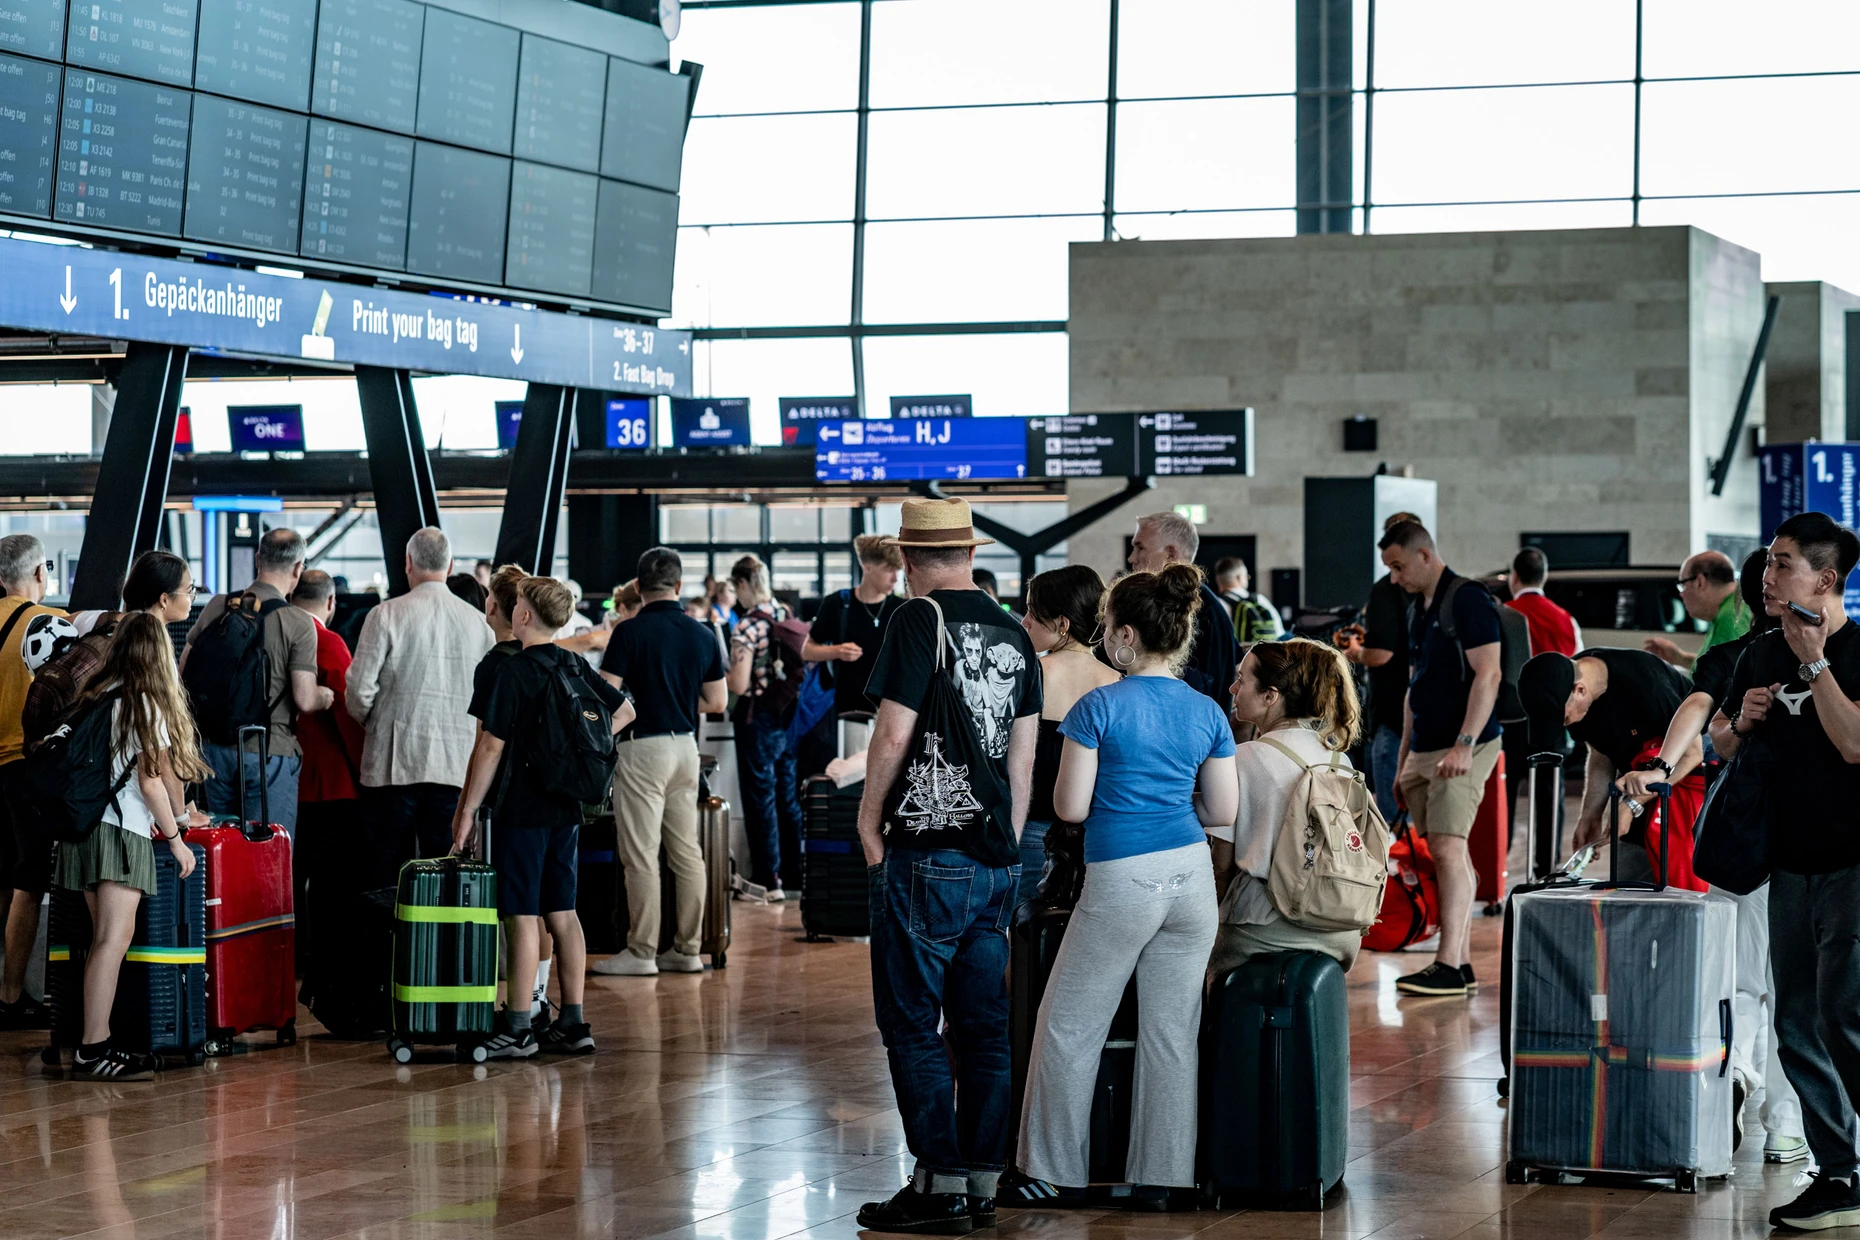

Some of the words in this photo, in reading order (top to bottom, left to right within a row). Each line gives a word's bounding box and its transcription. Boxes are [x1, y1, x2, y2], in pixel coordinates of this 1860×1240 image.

[73, 4, 88, 16] 11:45
[12, 11, 27, 24] offen
[72, 24, 87, 37] 11:50
[10, 33, 25, 45] offen
[8, 64, 23, 76] offen
[68, 76, 83, 88] 12:00
[66, 98, 82, 109] 12:00
[4, 106, 15, 120] bag
[16, 110, 26, 123] tag
[64, 118, 80, 130] 12:05
[63, 140, 78, 151] 12:05
[153, 134, 166, 146] Gran
[0, 149, 16, 161] offen
[61, 160, 76, 172] 12:10
[150, 175, 162, 186] Paris
[60, 181, 75, 193] 12:10
[58, 202, 73, 214] 12:30
[109, 268, 130, 320] 1.
[145, 271, 282, 328] Gepäckanhänger
[352, 300, 390, 334] Print
[392, 314, 423, 343] your
[427, 309, 452, 350] bag
[456, 316, 478, 352] tag
[614, 360, 622, 380] 2.
[623, 362, 640, 383] Fast
[641, 364, 655, 389] Bag
[656, 366, 675, 390] Drop
[800, 407, 839, 418] DELTA
[911, 406, 950, 417] DELTA
[254, 422, 286, 438] ONE
[618, 418, 646, 445] 36
[1812, 451, 1834, 483] 1.
